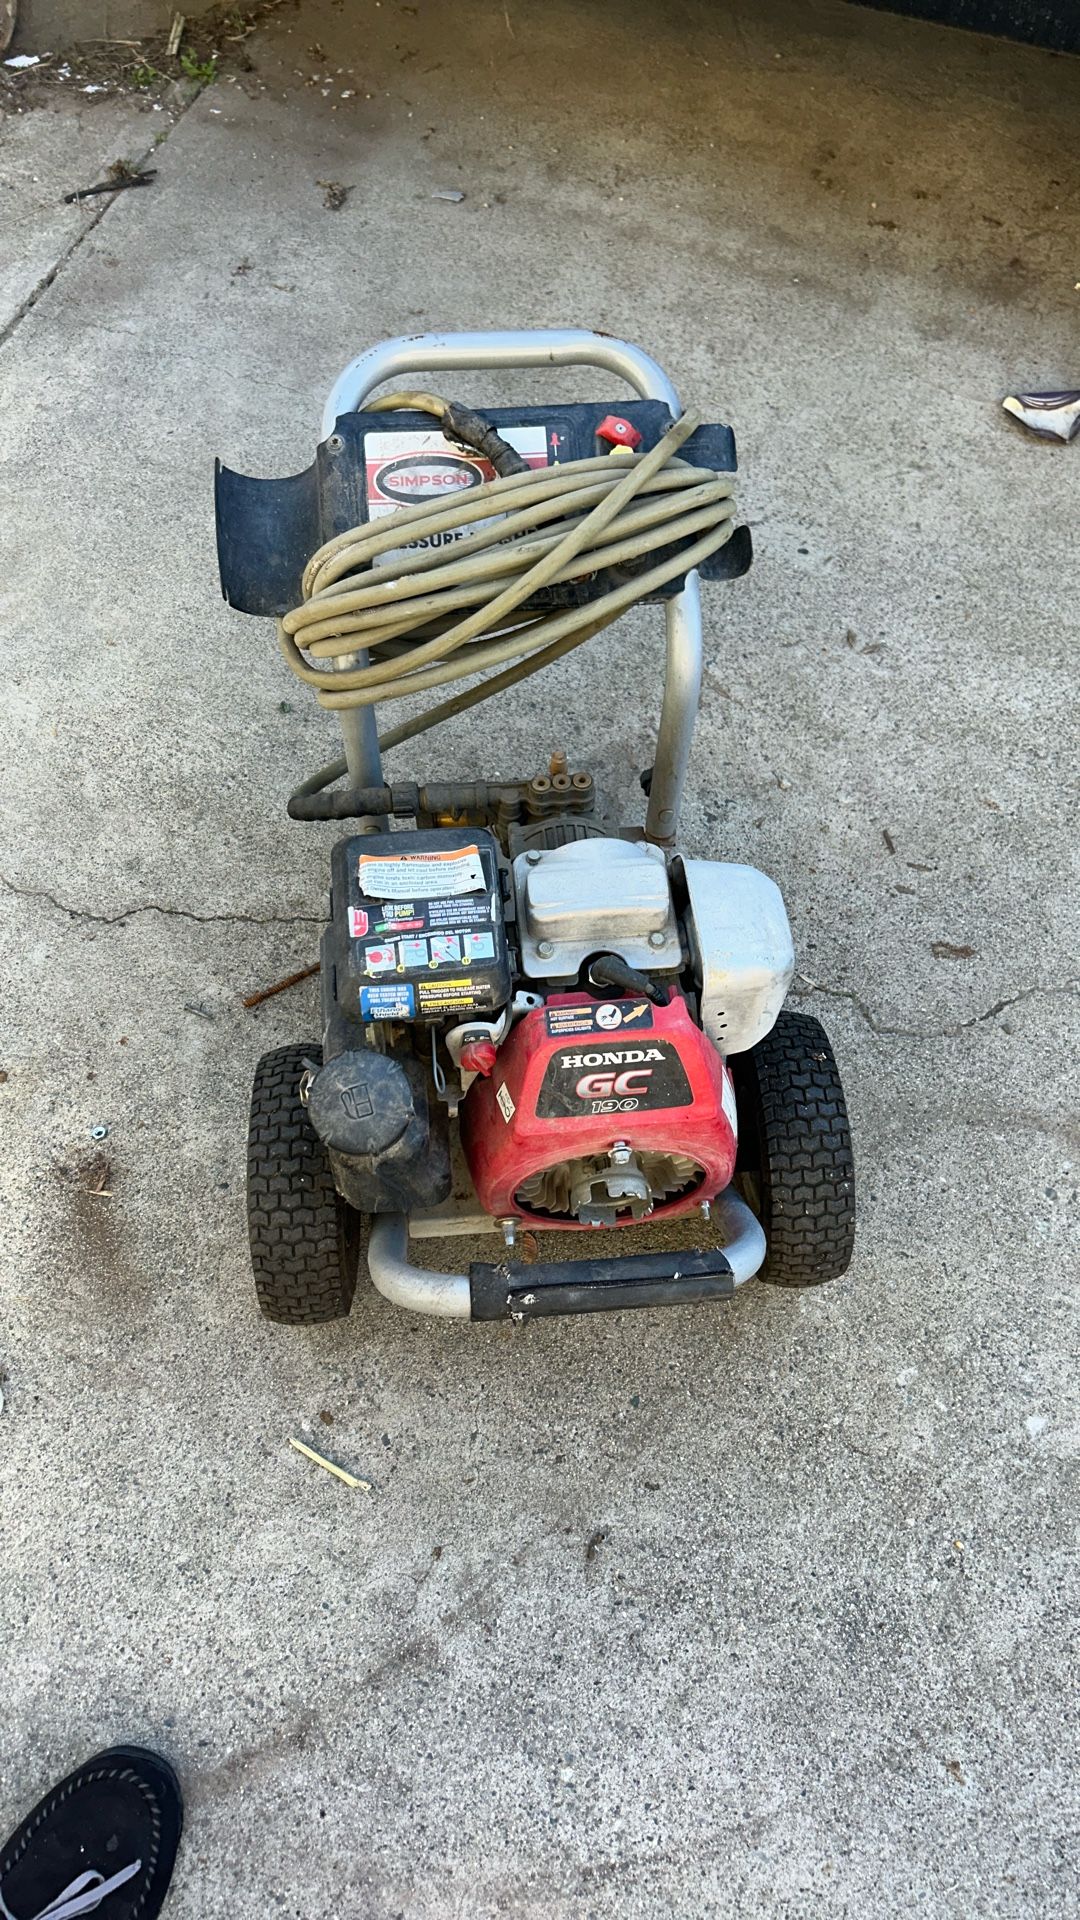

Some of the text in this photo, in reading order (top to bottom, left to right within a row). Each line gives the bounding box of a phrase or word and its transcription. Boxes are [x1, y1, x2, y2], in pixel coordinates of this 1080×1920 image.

[389, 474, 469, 487] SIMPSON
[561, 1048, 666, 1069] HONDA
[575, 1069, 653, 1099] GC
[592, 1097, 639, 1114] 190
